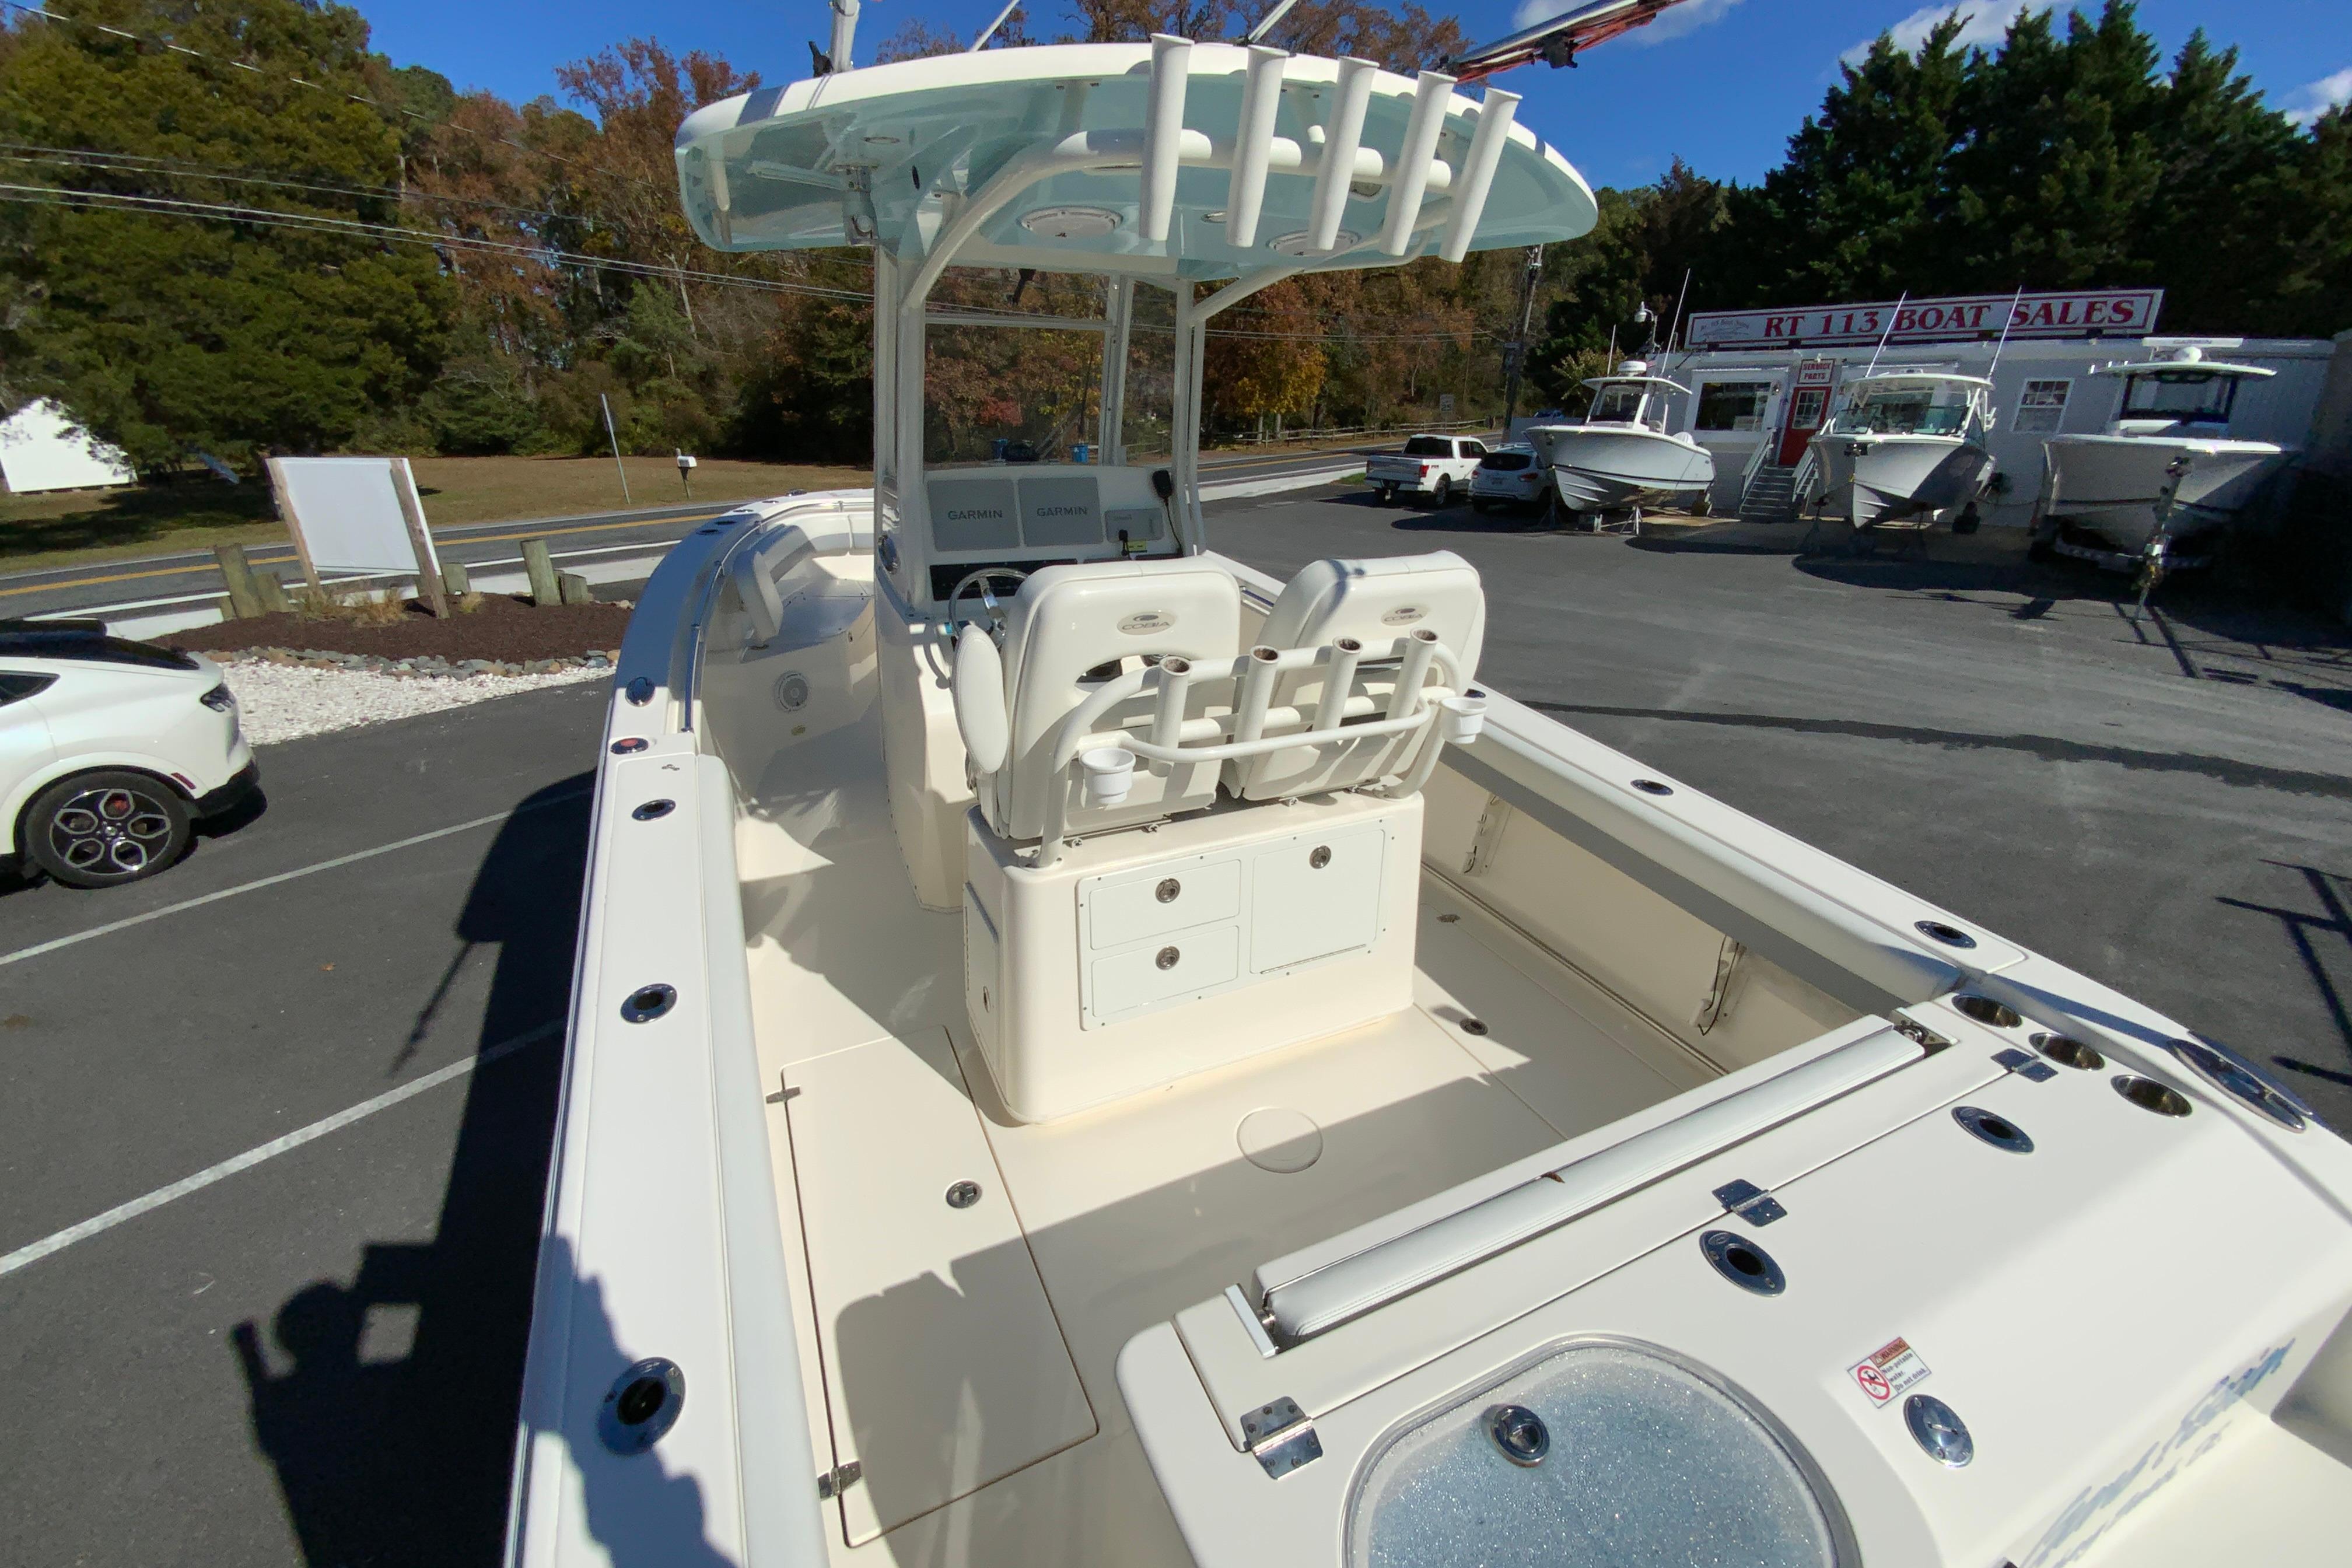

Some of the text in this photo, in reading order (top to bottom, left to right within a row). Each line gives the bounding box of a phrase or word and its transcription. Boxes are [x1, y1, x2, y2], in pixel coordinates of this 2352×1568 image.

[1764, 316, 1805, 337] RT
[1817, 312, 1879, 334] 113
[1891, 304, 1992, 331] BOAT
[2009, 299, 2134, 326] SALES
[947, 509, 1003, 520] GARMIN
[1037, 506, 1088, 517] GARMIN
[1384, 614, 1423, 622] COBIA
[1122, 621, 1170, 630] COBIA
[1880, 1340, 1906, 1359] WARNING
[1881, 1353, 1913, 1374] Non-potable
[1903, 1376, 1913, 1385] not
